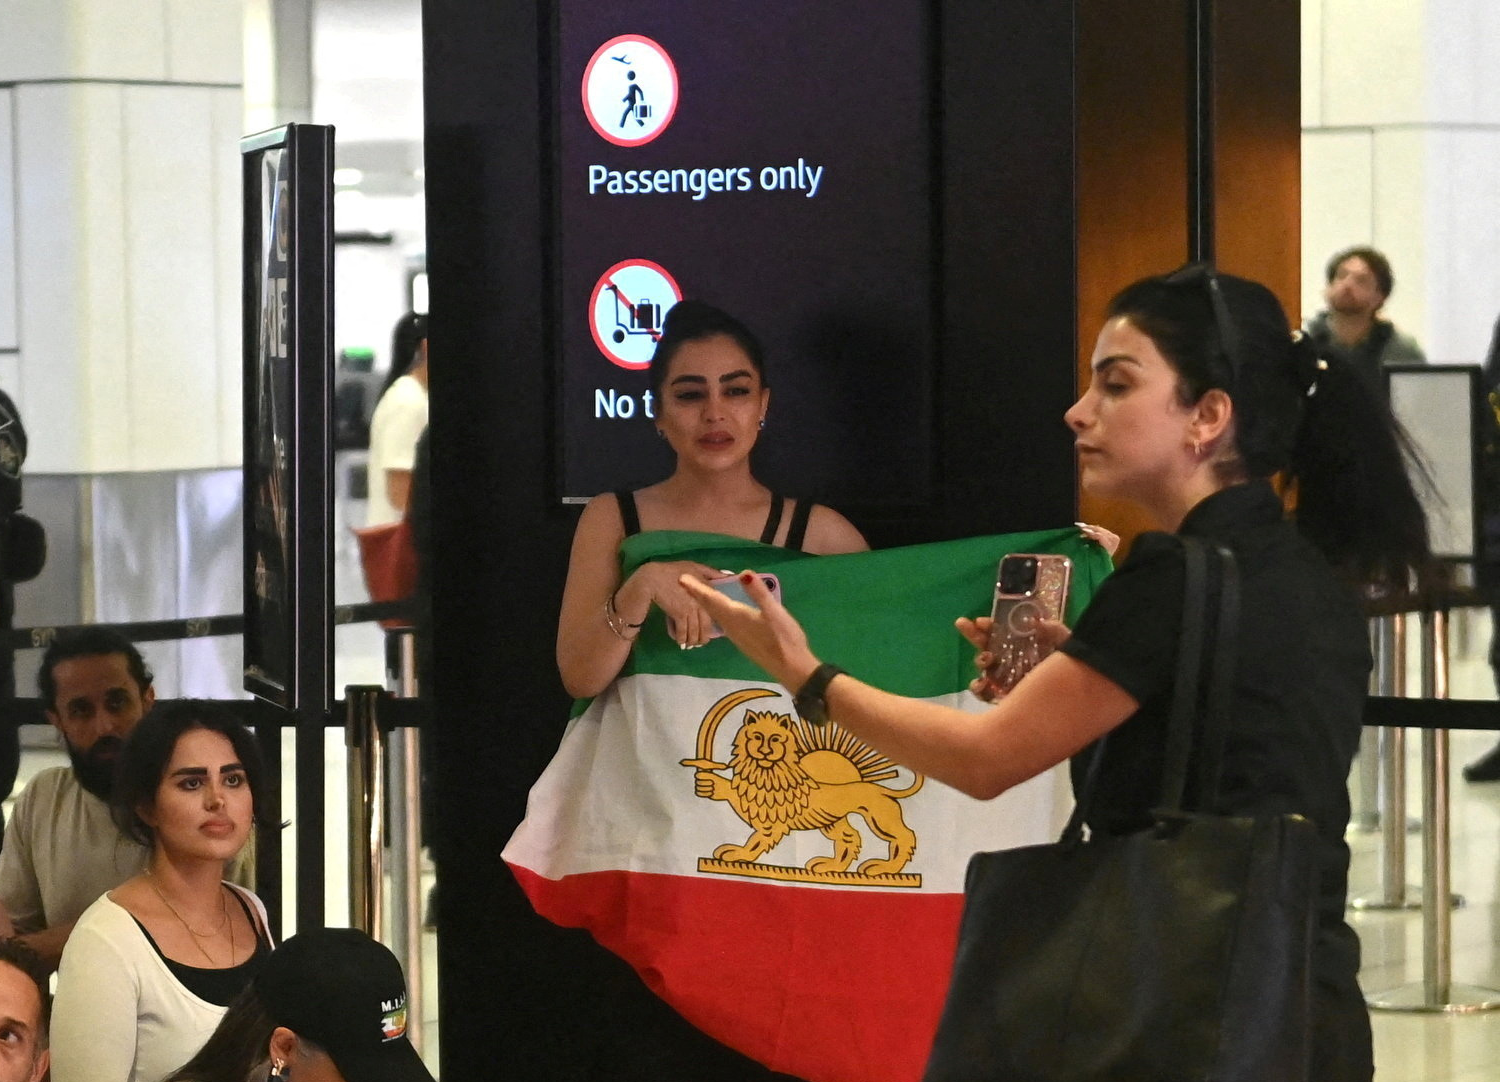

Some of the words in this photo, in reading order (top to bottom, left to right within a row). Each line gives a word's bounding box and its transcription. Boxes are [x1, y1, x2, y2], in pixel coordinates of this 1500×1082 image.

[588, 164, 752, 201] Passengers
[759, 157, 824, 198] only
[594, 388, 635, 419] No
